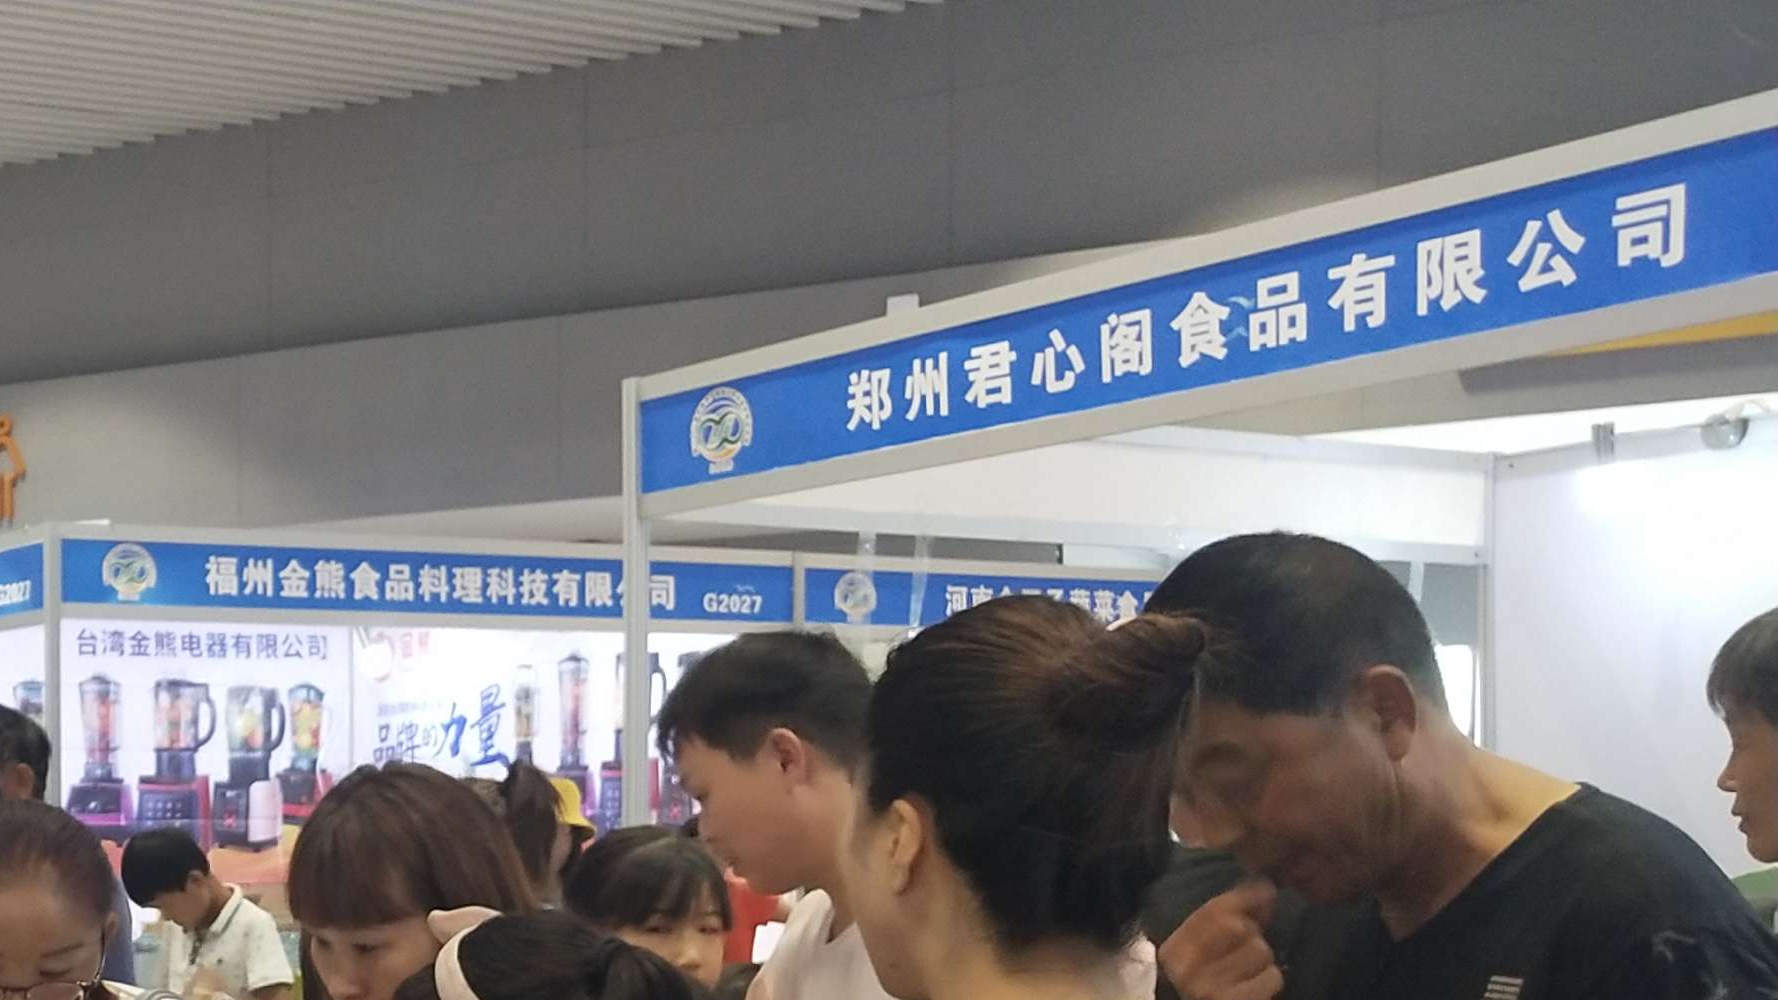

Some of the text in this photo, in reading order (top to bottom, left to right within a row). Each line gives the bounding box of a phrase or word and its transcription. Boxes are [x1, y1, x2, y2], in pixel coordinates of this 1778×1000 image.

[846, 183, 1688, 432] 郑州君心阁食品有限公司
[703, 592, 763, 614] G2027
[77, 628, 328, 660] 台湾金熊电器有限公司
